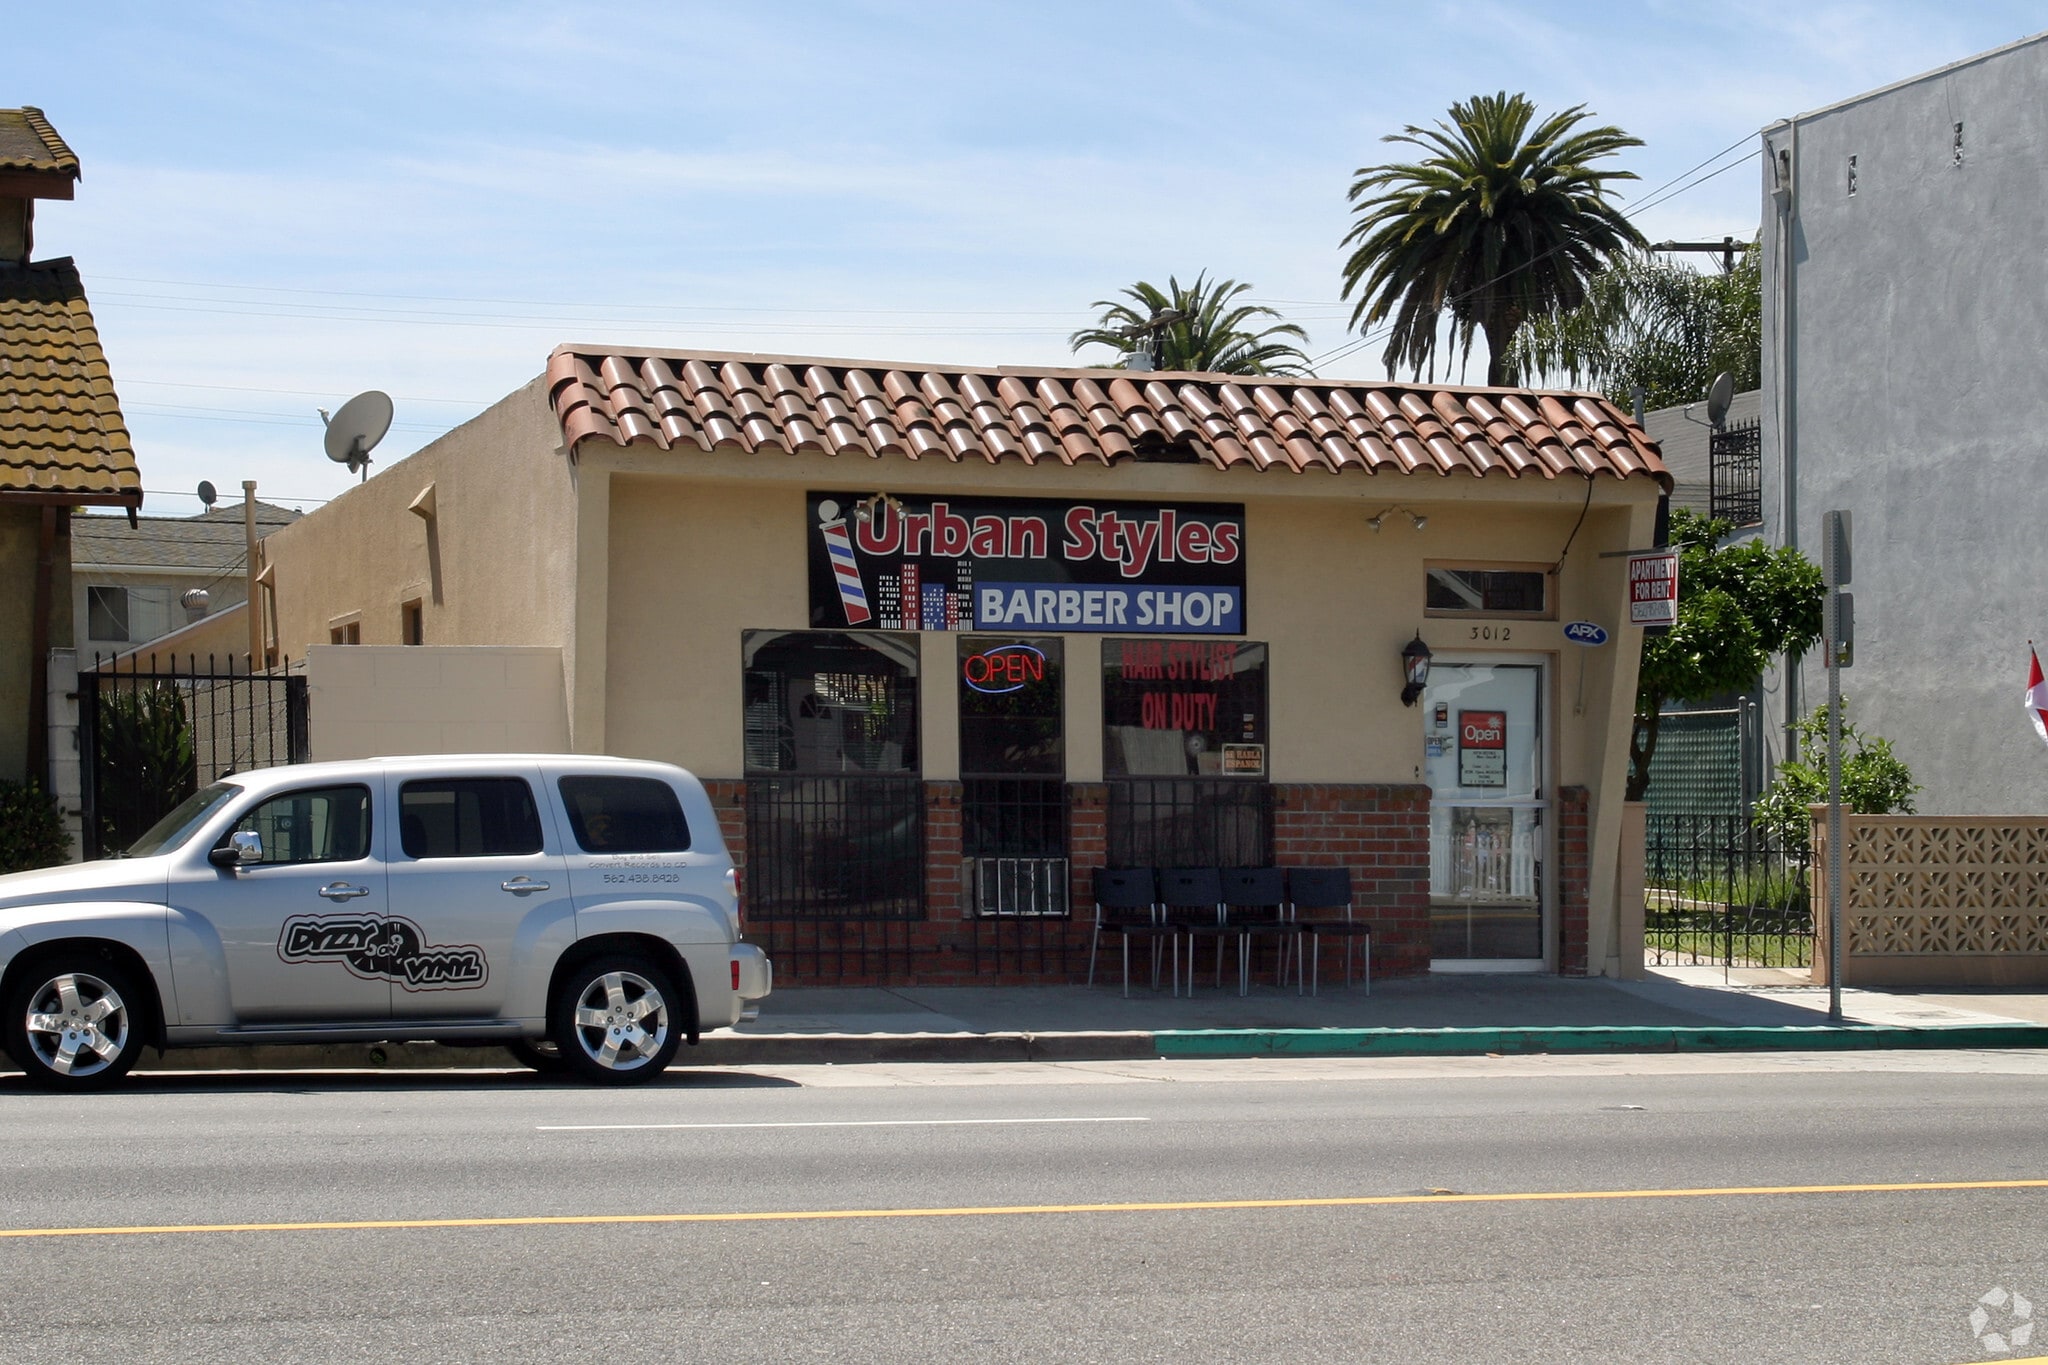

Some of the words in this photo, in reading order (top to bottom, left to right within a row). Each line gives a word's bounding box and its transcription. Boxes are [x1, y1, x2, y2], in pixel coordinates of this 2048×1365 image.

[855, 499, 1048, 559] Urban
[1063, 505, 1240, 579] Styles
[1631, 557, 1675, 580] APARTMENT
[1635, 582, 1650, 600] FOR
[1651, 580, 1671, 599] RENT
[981, 588, 1128, 626] BARBER
[1135, 591, 1234, 627] SHOP
[1470, 626, 1510, 641] 3012
[1568, 624, 1600, 639] APX
[964, 653, 1044, 682] OPEN
[1121, 640, 1163, 680] HAIR
[1168, 642, 1237, 681] STYLIST
[1142, 692, 1167, 730] ON
[1172, 692, 1217, 731] DUTY
[1464, 725, 1501, 743] Open
[288, 922, 379, 953] DYZZY
